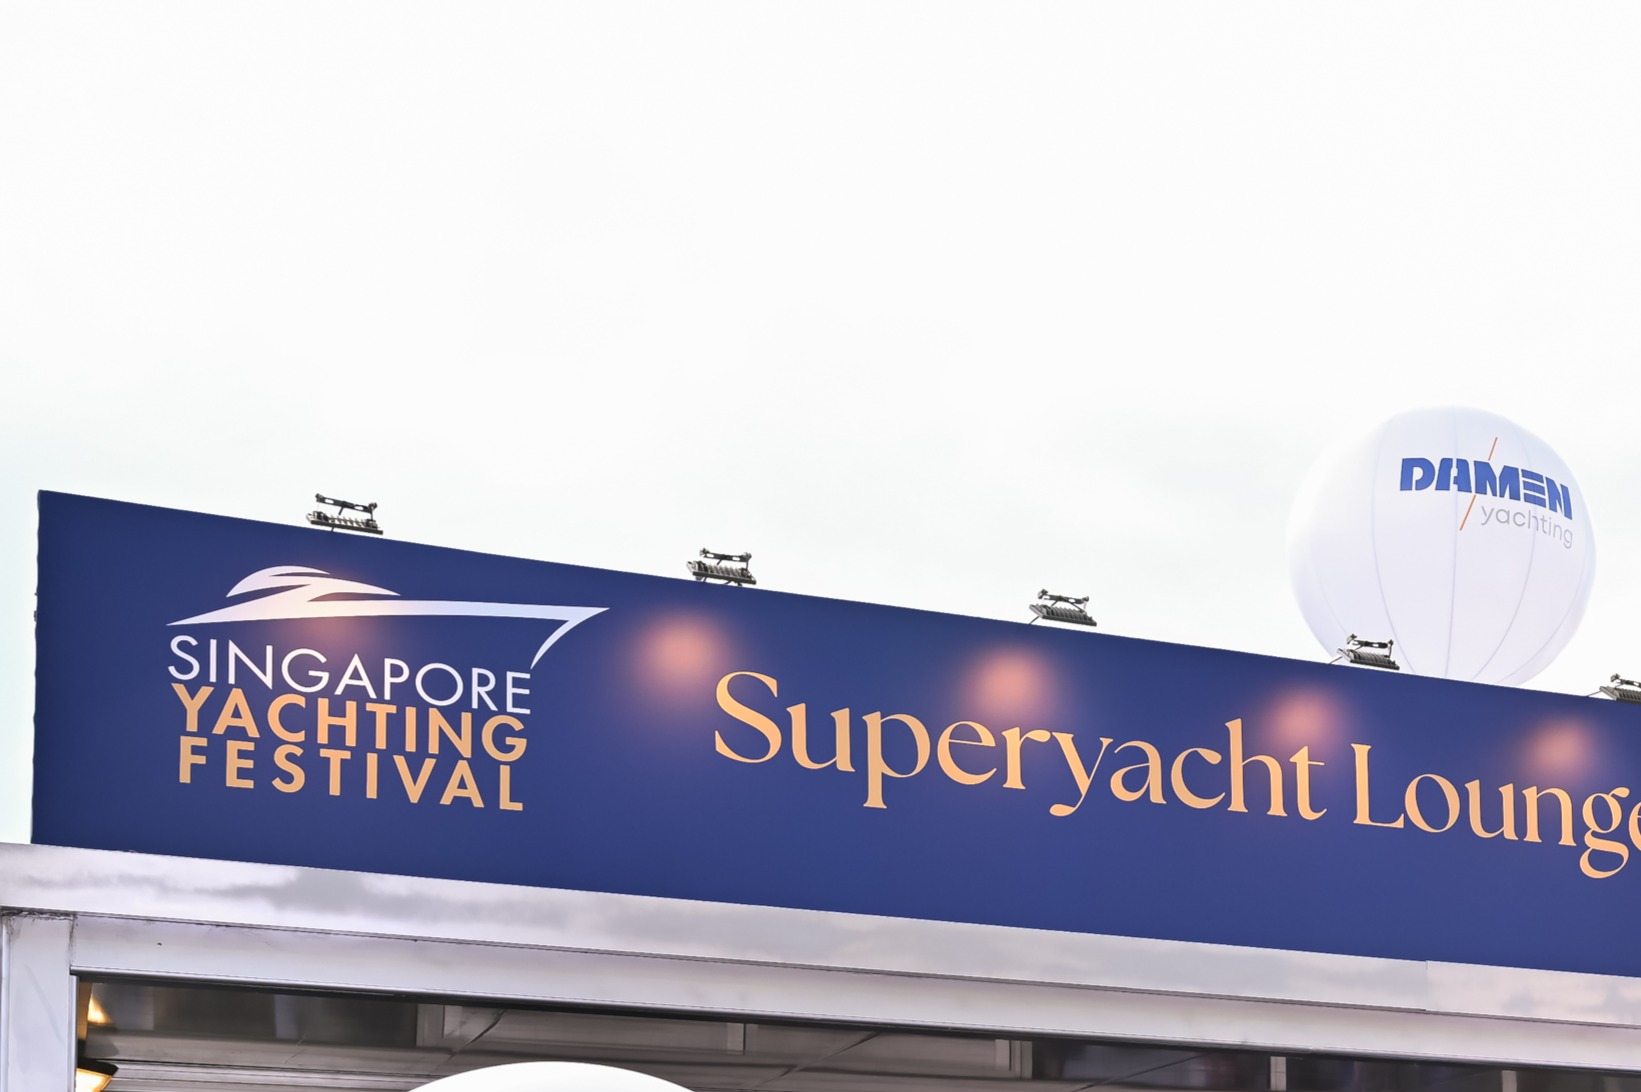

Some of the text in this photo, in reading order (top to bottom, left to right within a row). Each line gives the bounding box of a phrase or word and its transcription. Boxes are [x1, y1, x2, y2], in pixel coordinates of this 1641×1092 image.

[1400, 457, 1573, 520] DAMEN
[1481, 504, 1574, 549] yachting
[168, 634, 531, 715] SINGAPORE
[170, 682, 528, 762] YACHTING
[714, 670, 1327, 818] Superyacht
[179, 735, 523, 811] FESTIVAL
